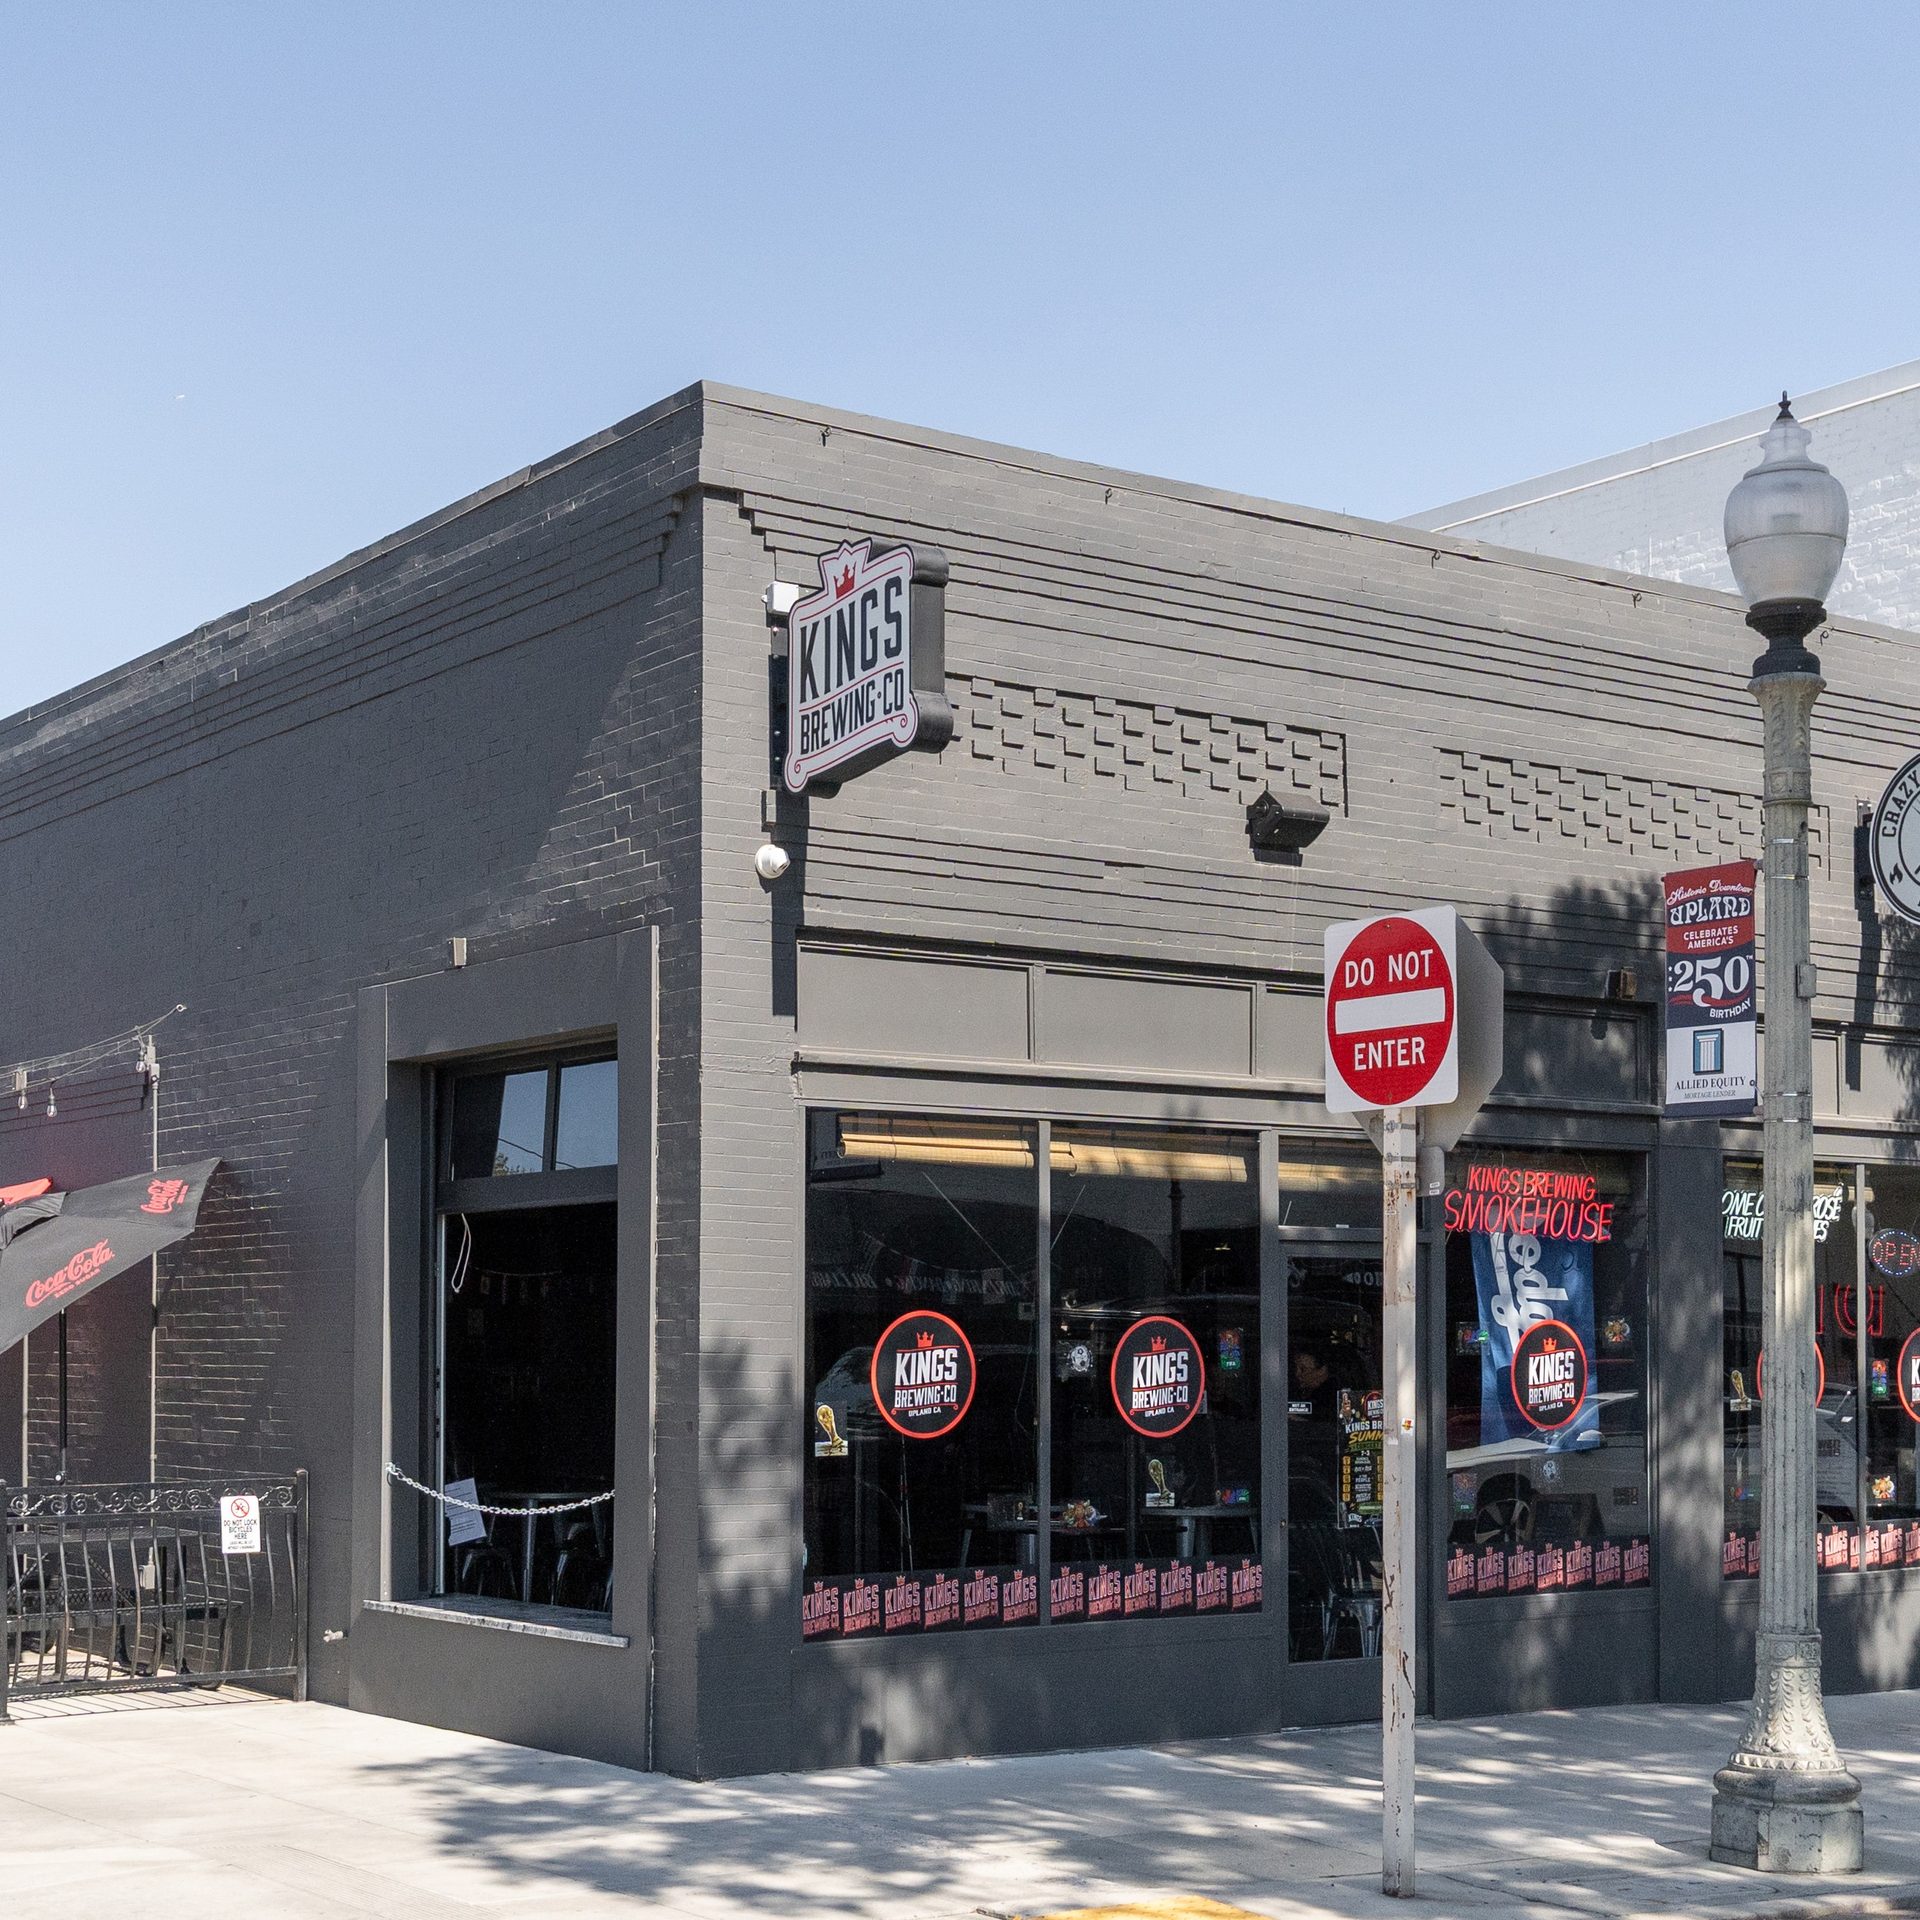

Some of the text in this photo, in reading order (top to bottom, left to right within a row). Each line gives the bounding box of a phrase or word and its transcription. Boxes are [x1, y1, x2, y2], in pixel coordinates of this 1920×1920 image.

[800, 576, 902, 704] KINGS
[1670, 896, 1751, 926] UPLAND
[1683, 925, 1739, 941] CELEBRATES
[1687, 935, 1734, 949] AMERICA'S
[1345, 949, 1434, 989] DO NOT
[1709, 998, 1752, 1019] BIRTHDAY
[1354, 1036, 1426, 1072] ENTER
[1675, 1076, 1746, 1091] ALLIED EQUITY
[1713, 1089, 1736, 1098] LENDER
[1468, 1165, 1520, 1195] KINGS
[1523, 1170, 1597, 1201] BREWING
[1444, 1190, 1614, 1242] SMOKEHOUSE
[1722, 1190, 1756, 1216] OME
[1727, 1216, 1764, 1238] FRUIT
[894, 1348, 958, 1386] KINGS
[1132, 1351, 1188, 1388] KINGS
[1528, 1350, 1575, 1385] KINGS
[908, 1408, 932, 1417] UPLAND
[1345, 1421, 1383, 1433] KINGS BR
[1348, 1430, 1383, 1444] SUMM
[1448, 1554, 1474, 1581] KINGS
[1478, 1552, 1504, 1579] KINGS
[1508, 1551, 1534, 1577] KINGS
[1537, 1548, 1563, 1576] KINGS
[1566, 1546, 1592, 1572] KINGS
[1596, 1546, 1620, 1573] KINGS
[1624, 1544, 1649, 1571] KINGS
[964, 1576, 998, 1607] KINGS
[1003, 1576, 1036, 1606] KINGS
[1051, 1572, 1083, 1602] KINGS
[1089, 1571, 1120, 1600] KINGS
[1124, 1568, 1156, 1599] KINGS
[1161, 1566, 1192, 1595] KINGS
[1197, 1567, 1227, 1595] KINGS
[1232, 1565, 1262, 1594] KINGS
[803, 1588, 838, 1620] KINGS
[844, 1584, 879, 1617] KINGS
[885, 1582, 920, 1614] KINGS
[925, 1580, 959, 1611] KINGS
